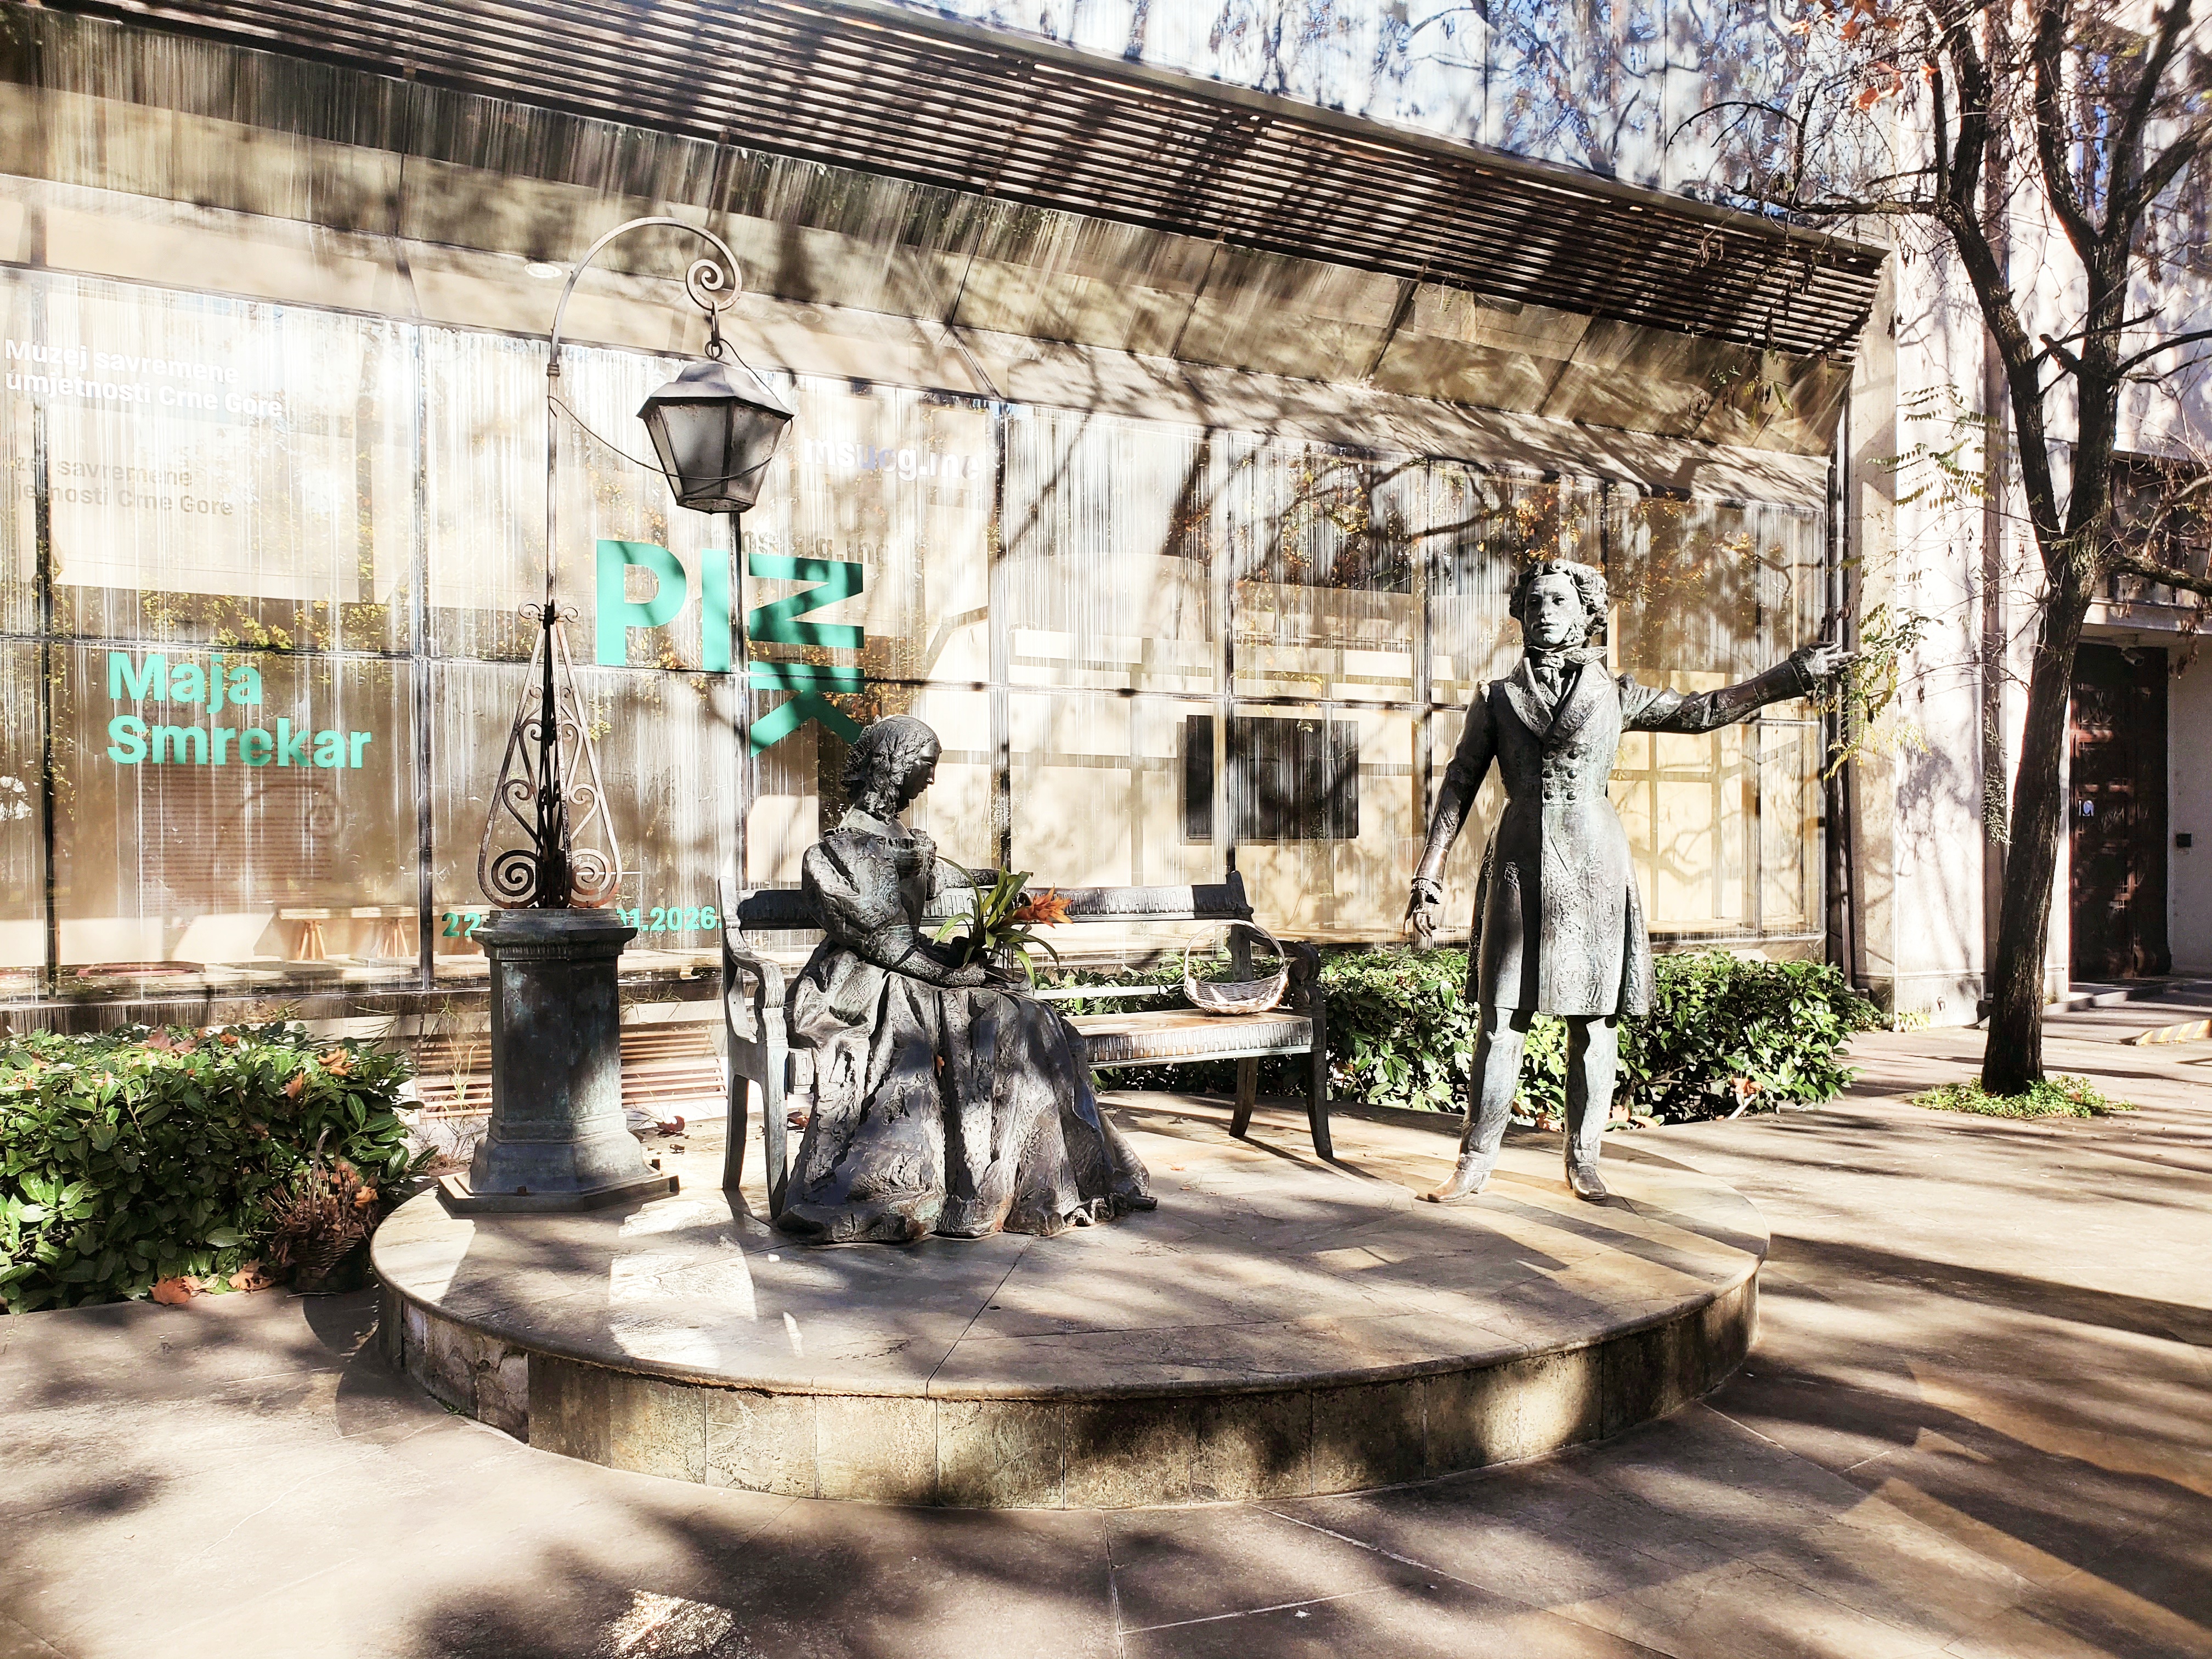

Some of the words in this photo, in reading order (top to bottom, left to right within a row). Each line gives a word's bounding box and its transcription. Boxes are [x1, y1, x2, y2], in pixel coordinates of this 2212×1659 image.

[4, 338, 87, 372] Muzej
[95, 351, 240, 384] savremene
[6, 371, 151, 403] umjetnosti
[159, 385, 219, 411] Crne
[224, 392, 283, 417] Gore
[804, 438, 979, 481] msucg.me
[110, 652, 261, 714] Maja
[107, 714, 371, 768] Smrekar
